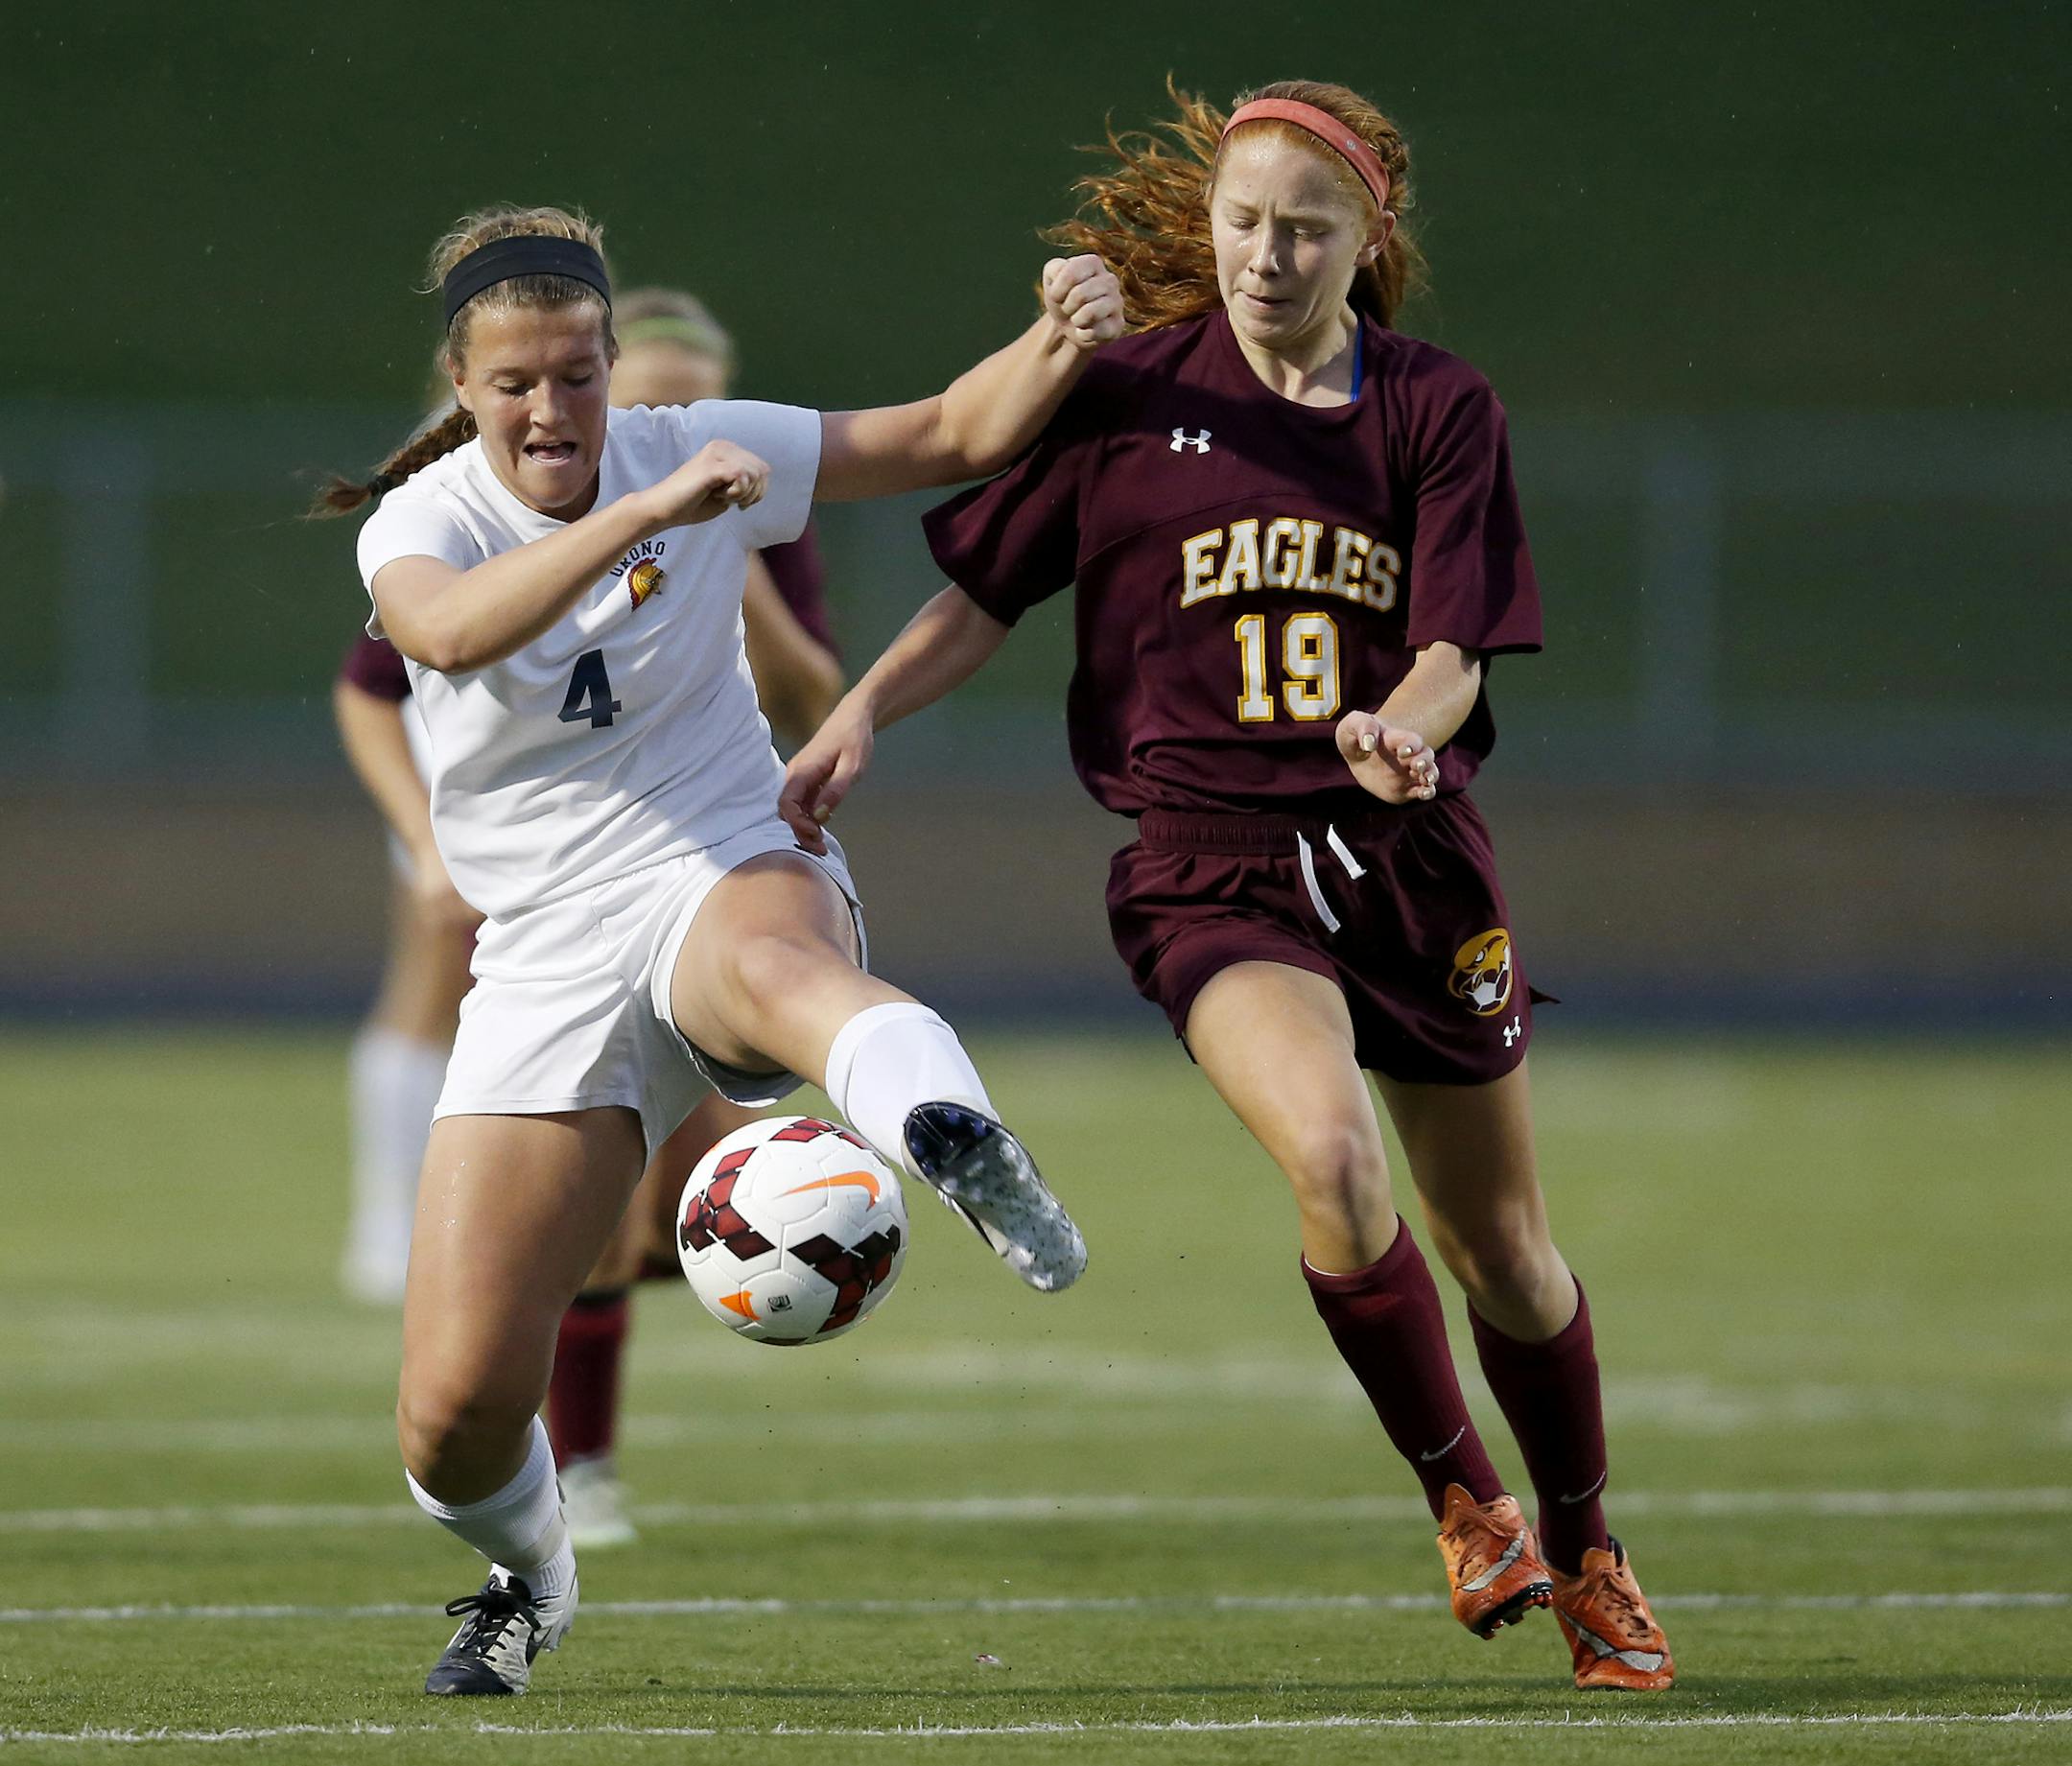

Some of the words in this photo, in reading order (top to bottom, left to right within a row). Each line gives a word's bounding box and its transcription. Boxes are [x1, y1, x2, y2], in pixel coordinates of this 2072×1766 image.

[1180, 517, 1401, 613] EAGLES
[557, 648, 623, 729] 4
[1234, 612, 1341, 722] 19
